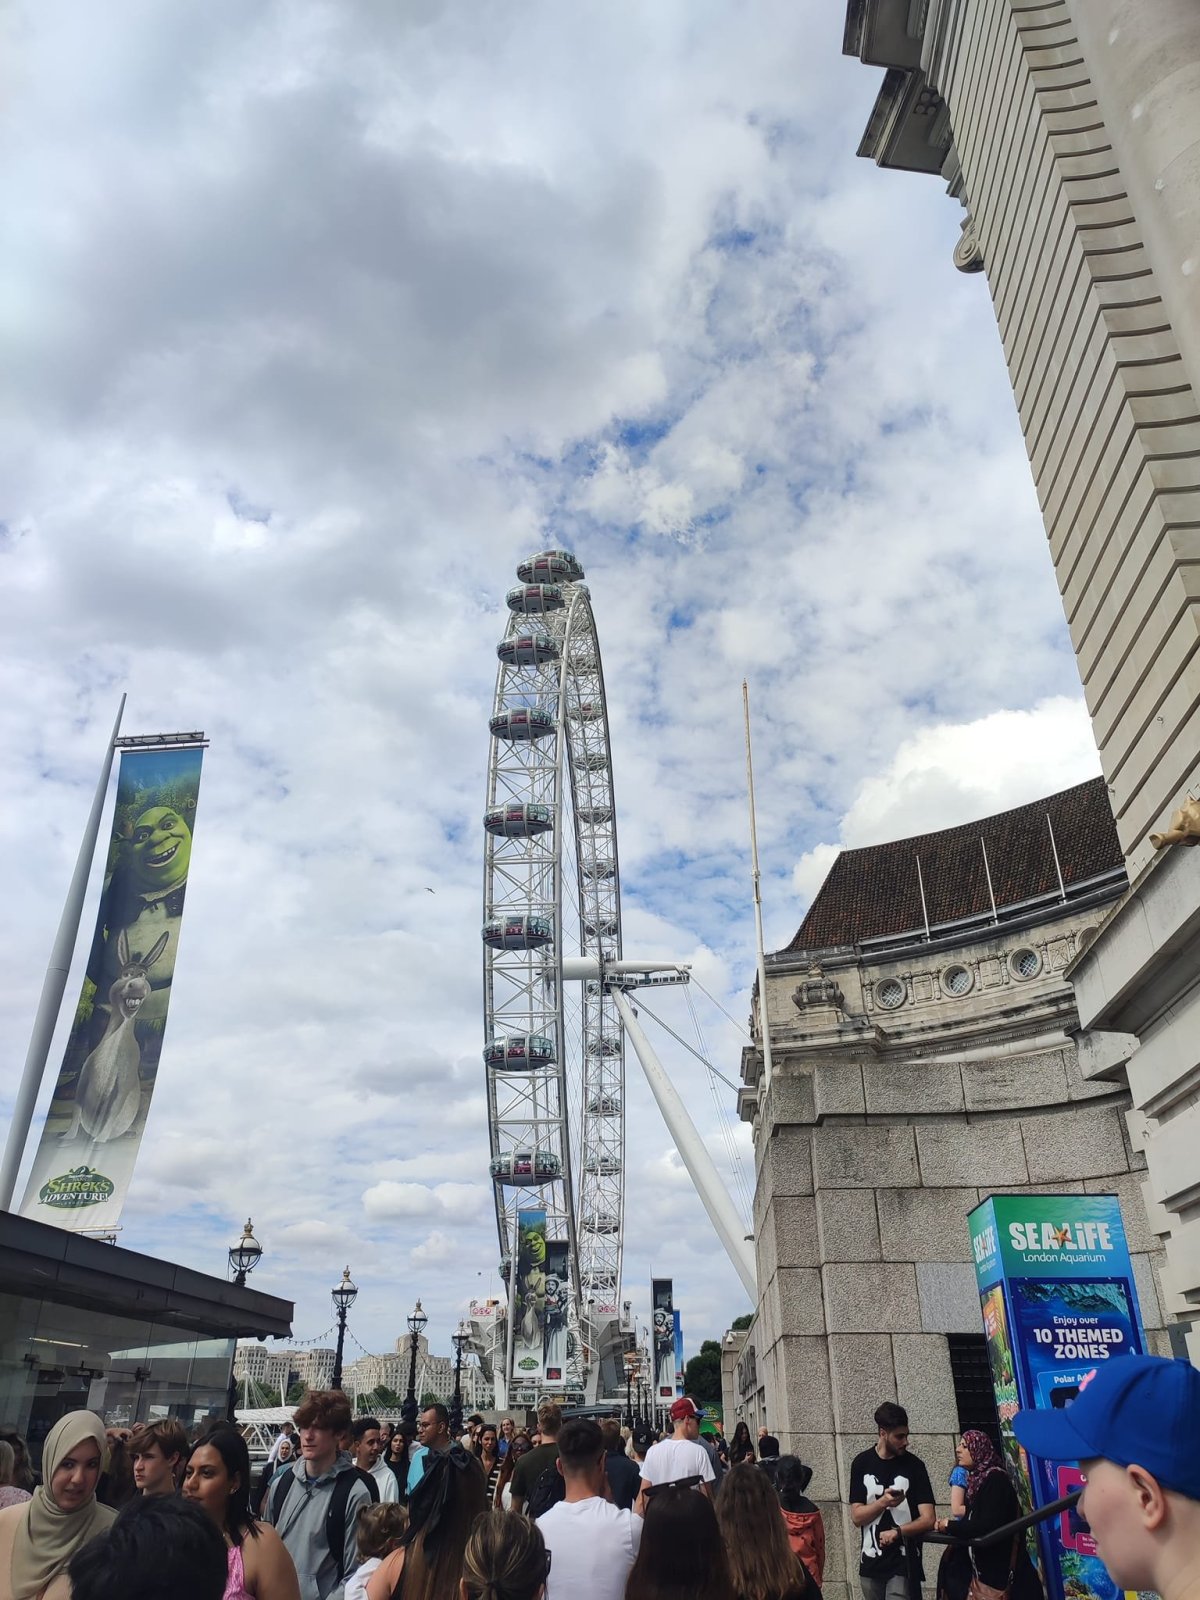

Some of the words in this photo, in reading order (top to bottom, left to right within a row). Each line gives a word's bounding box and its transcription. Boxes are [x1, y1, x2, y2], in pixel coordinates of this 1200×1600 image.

[42, 1192, 109, 1203] ADVENTURE!
[1008, 1223, 1060, 1250] SEA
[1023, 1252, 1058, 1262] London
[1060, 1253, 1106, 1264] Aquarium
[1053, 1316, 1077, 1326] Enjoy
[1033, 1329, 1052, 1343] 10
[1055, 1329, 1123, 1343] THEMED
[1054, 1344, 1110, 1359] ZONES
[1053, 1374, 1075, 1384] Polar
